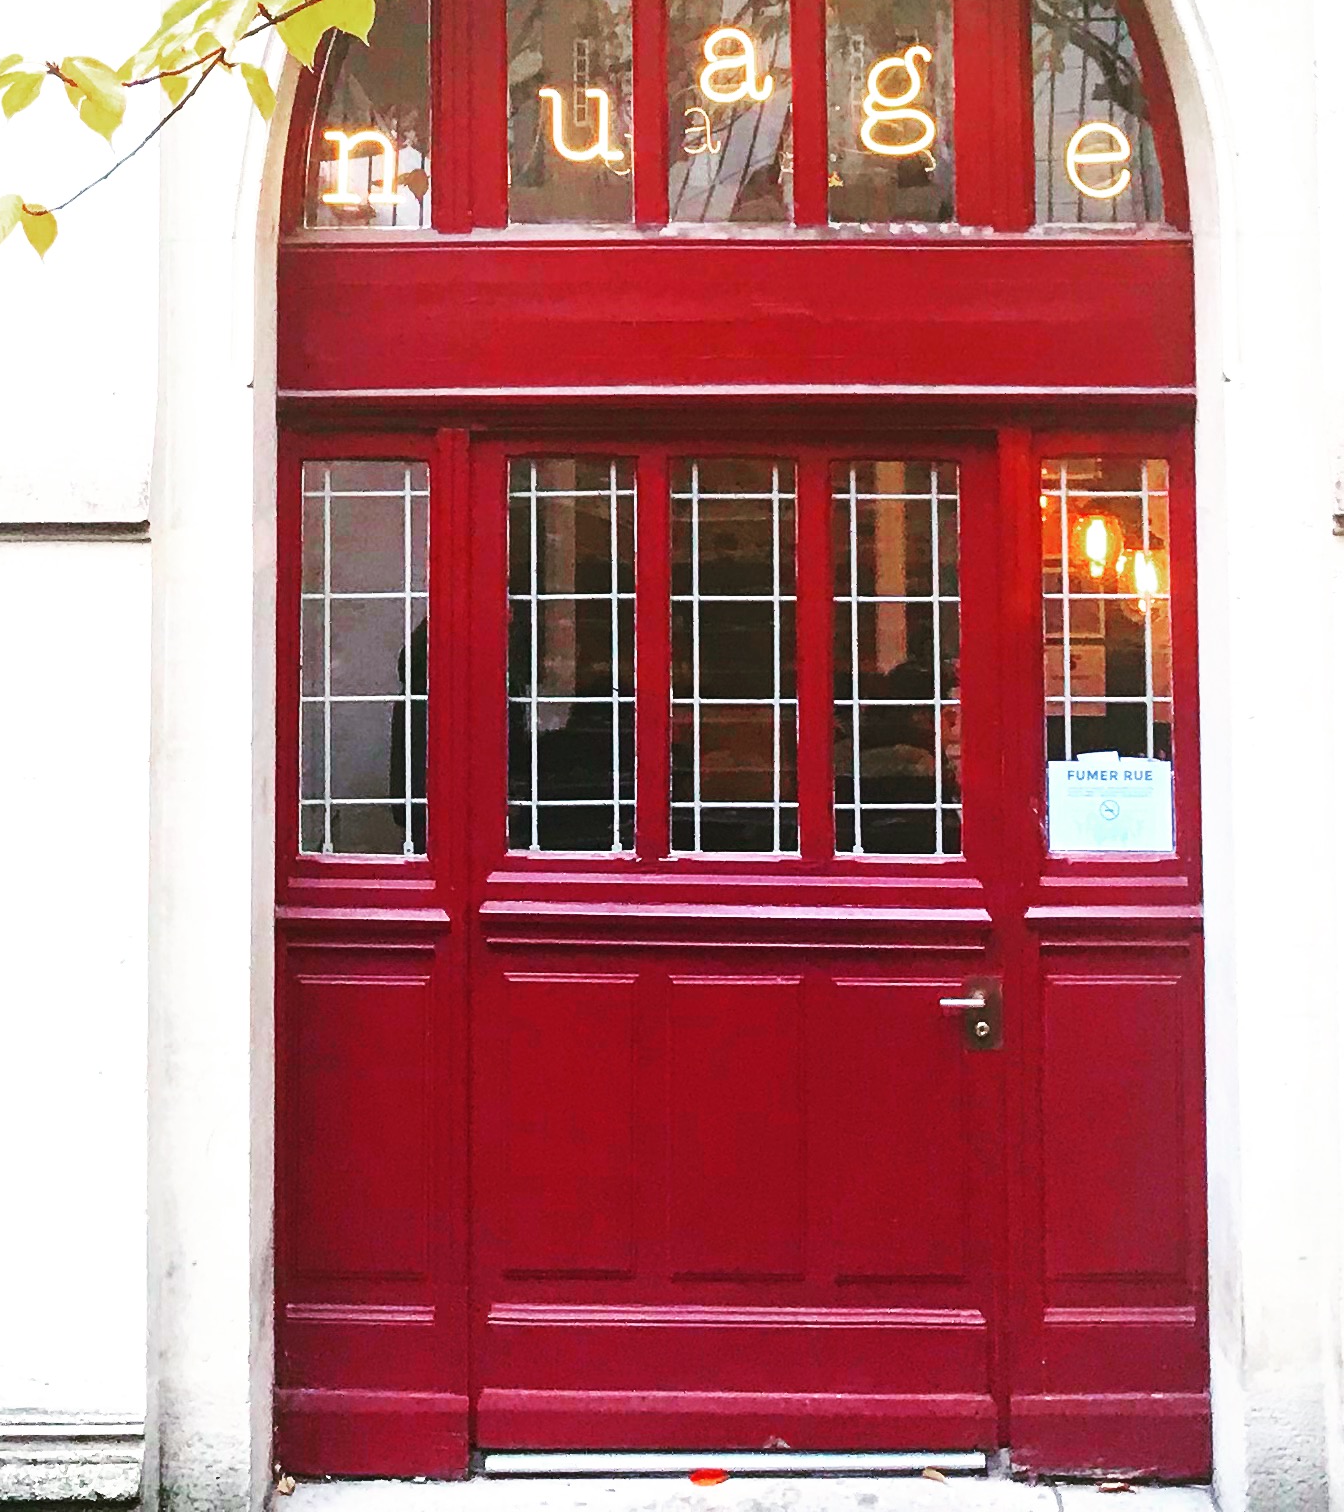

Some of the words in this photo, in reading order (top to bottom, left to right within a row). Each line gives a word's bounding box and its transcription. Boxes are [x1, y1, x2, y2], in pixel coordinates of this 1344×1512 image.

[321, 26, 1133, 205] nuage
[1067, 770, 1118, 781] FUMER
[1123, 770, 1153, 781] RUE
